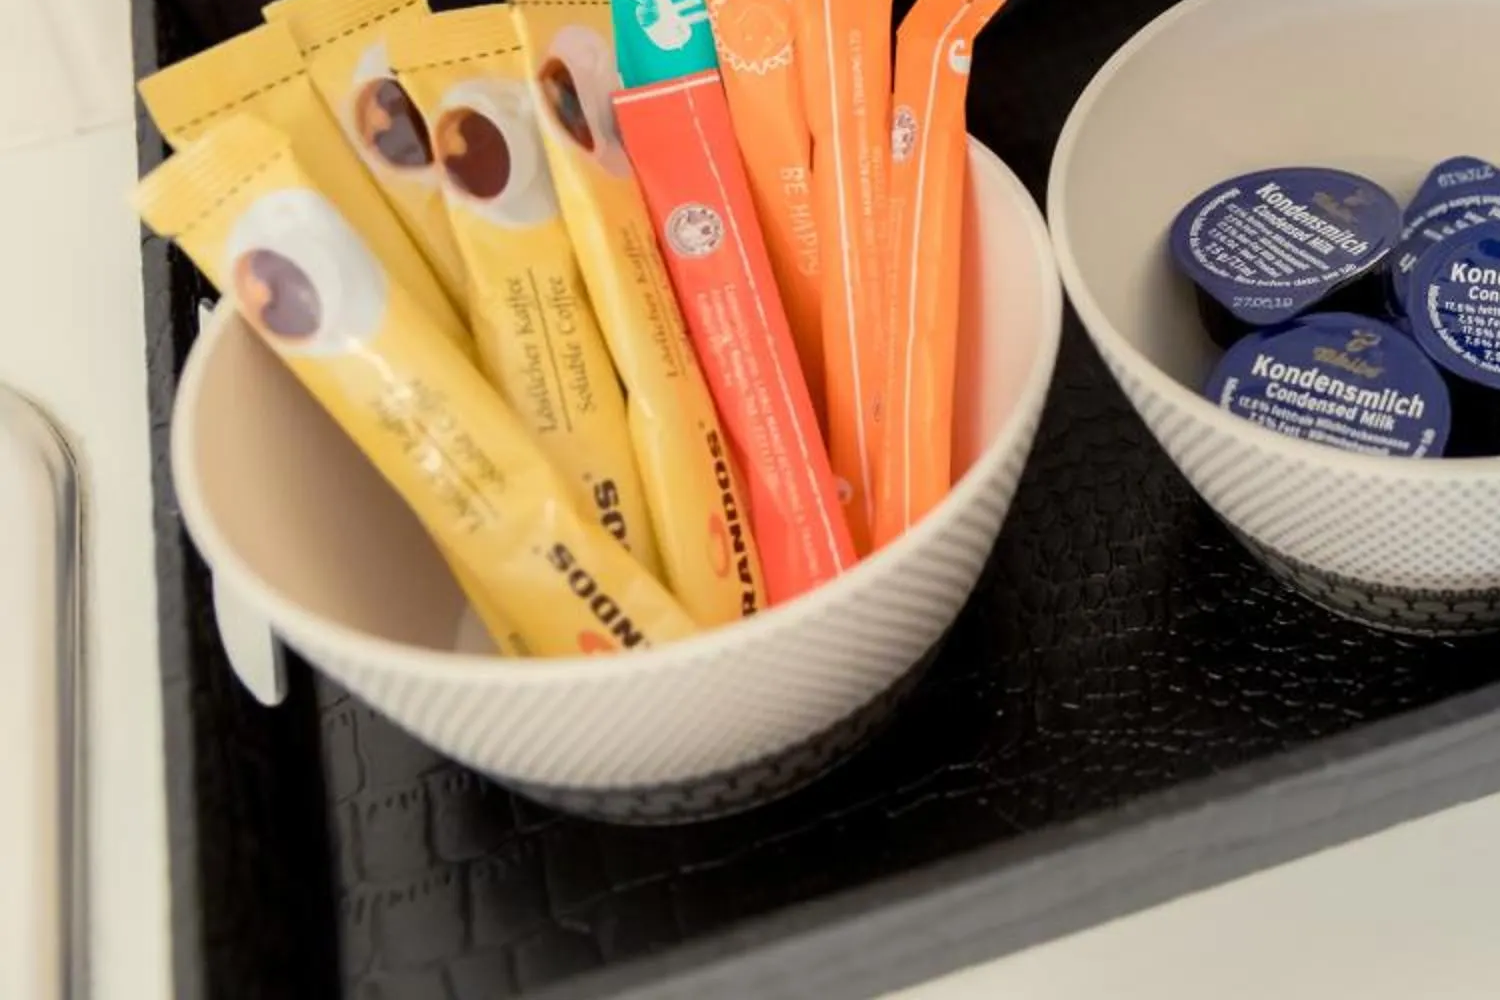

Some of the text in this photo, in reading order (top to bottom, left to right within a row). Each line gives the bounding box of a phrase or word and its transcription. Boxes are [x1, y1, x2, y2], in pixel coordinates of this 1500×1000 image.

[780, 165, 810, 195] BE
[1253, 203, 1314, 242] Condensed
[1306, 235, 1335, 255] Milk
[1256, 182, 1370, 256] Kondensmilch
[506, 276, 558, 434] Löslicher Kaffee
[549, 275, 597, 414] Soluble Coffee
[1251, 353, 1425, 420] Kondensmilch
[1265, 382, 1357, 420] Condensed
[1359, 409, 1396, 432] Milk
